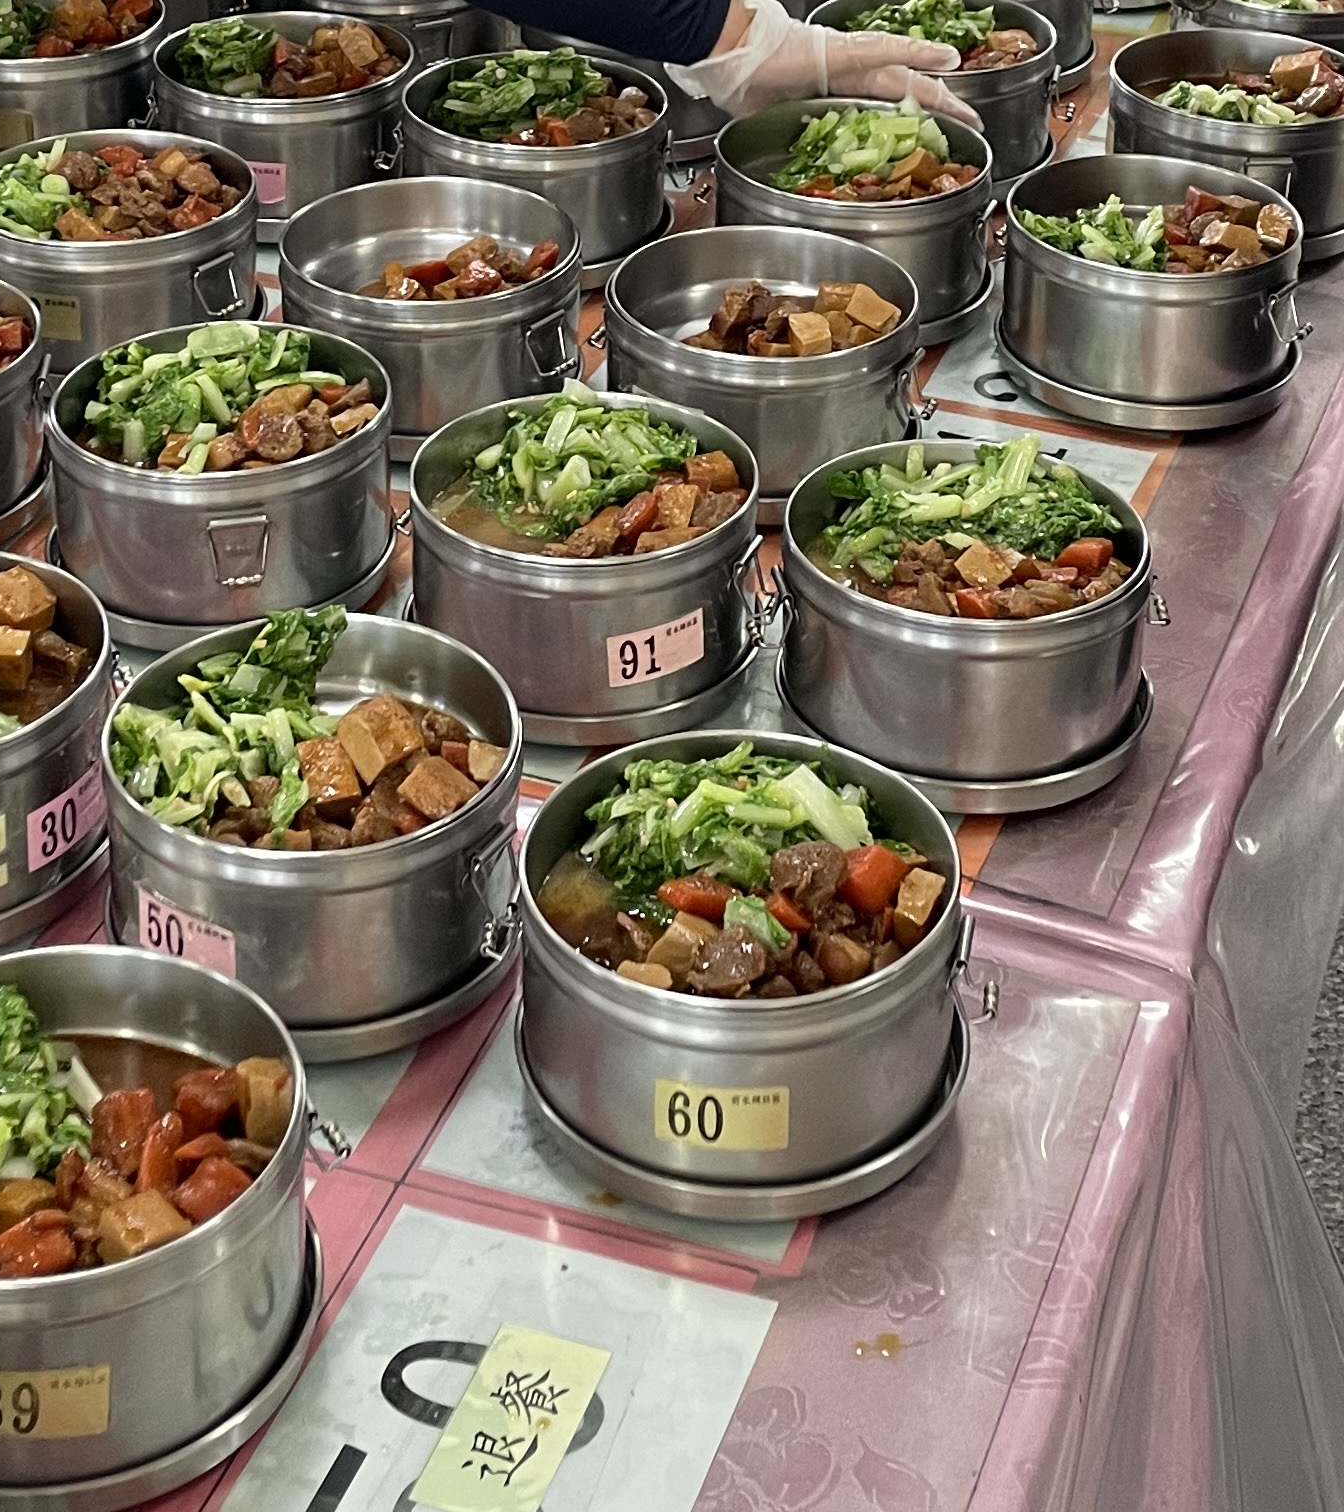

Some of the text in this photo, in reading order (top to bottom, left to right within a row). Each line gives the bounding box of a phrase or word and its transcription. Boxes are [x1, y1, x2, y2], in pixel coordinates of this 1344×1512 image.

[619, 634, 662, 680] 91
[40, 798, 78, 858] 30
[147, 900, 184, 957] 50
[668, 1091, 724, 1144] 60
[460, 1368, 570, 1487] 退餐
